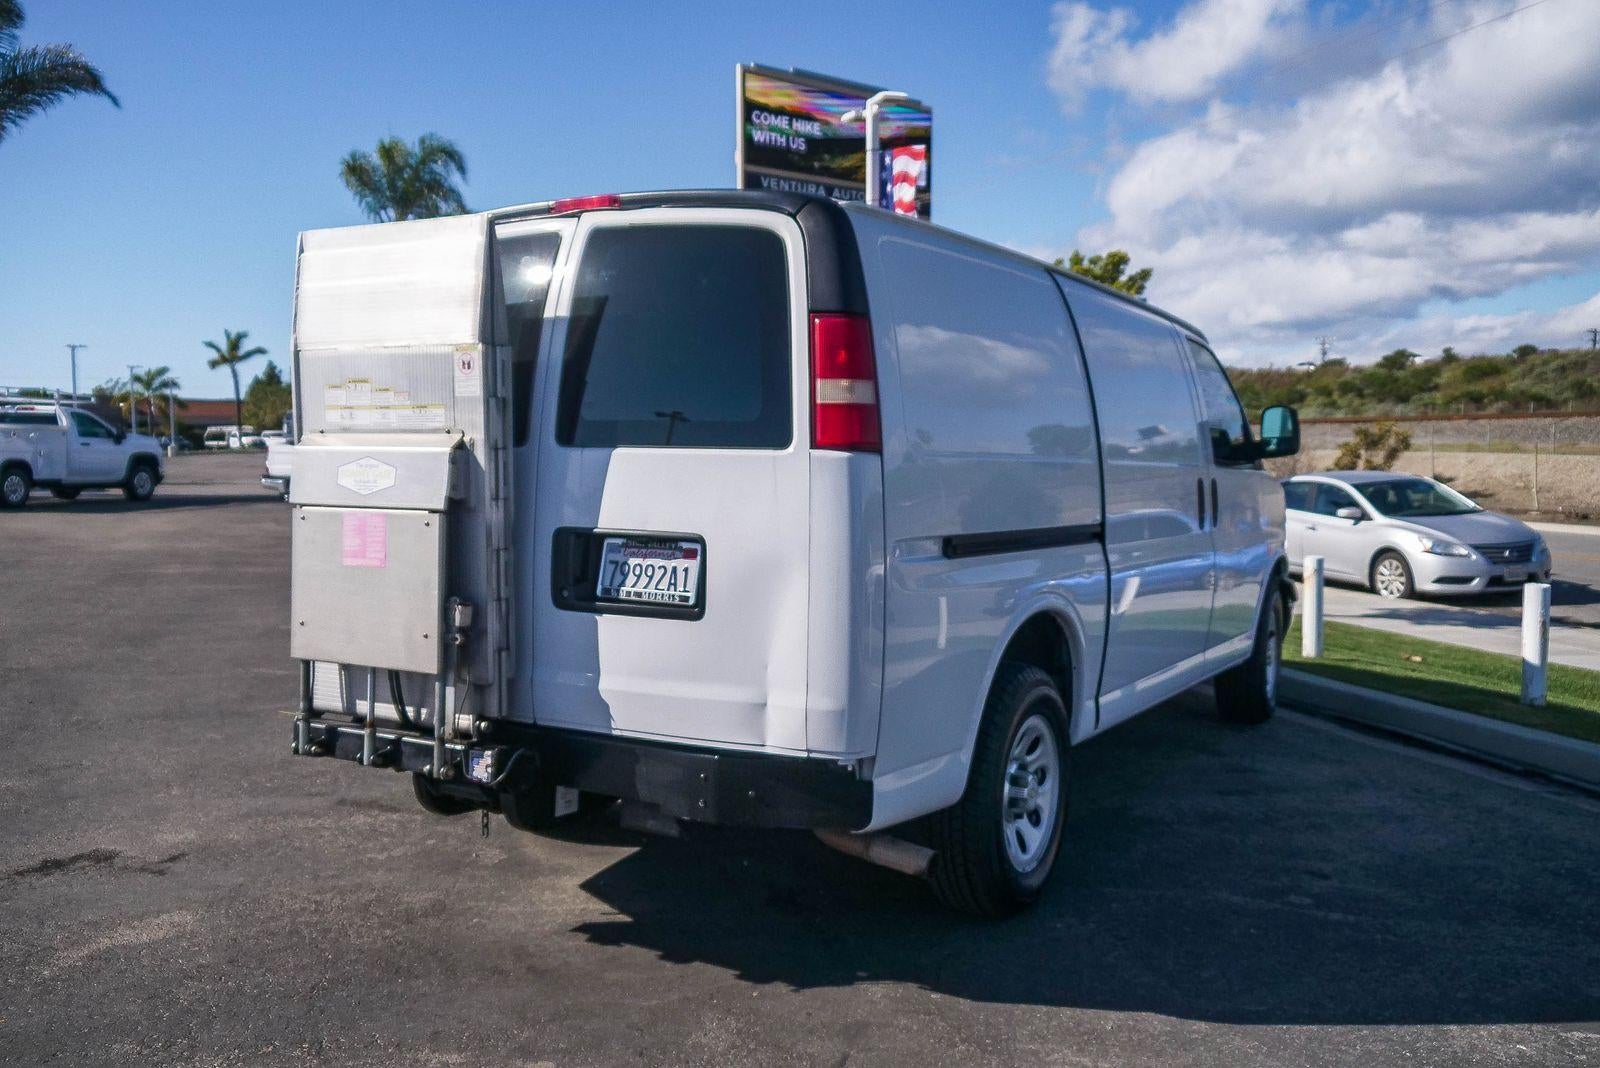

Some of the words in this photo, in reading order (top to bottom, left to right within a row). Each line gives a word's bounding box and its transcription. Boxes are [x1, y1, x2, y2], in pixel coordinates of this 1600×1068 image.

[751, 110, 790, 129] COME
[792, 119, 821, 136] HIKE
[752, 130, 786, 147] WITH
[789, 138, 806, 151] US
[761, 176, 826, 197] VENTURA
[608, 560, 690, 593] 79992A1
